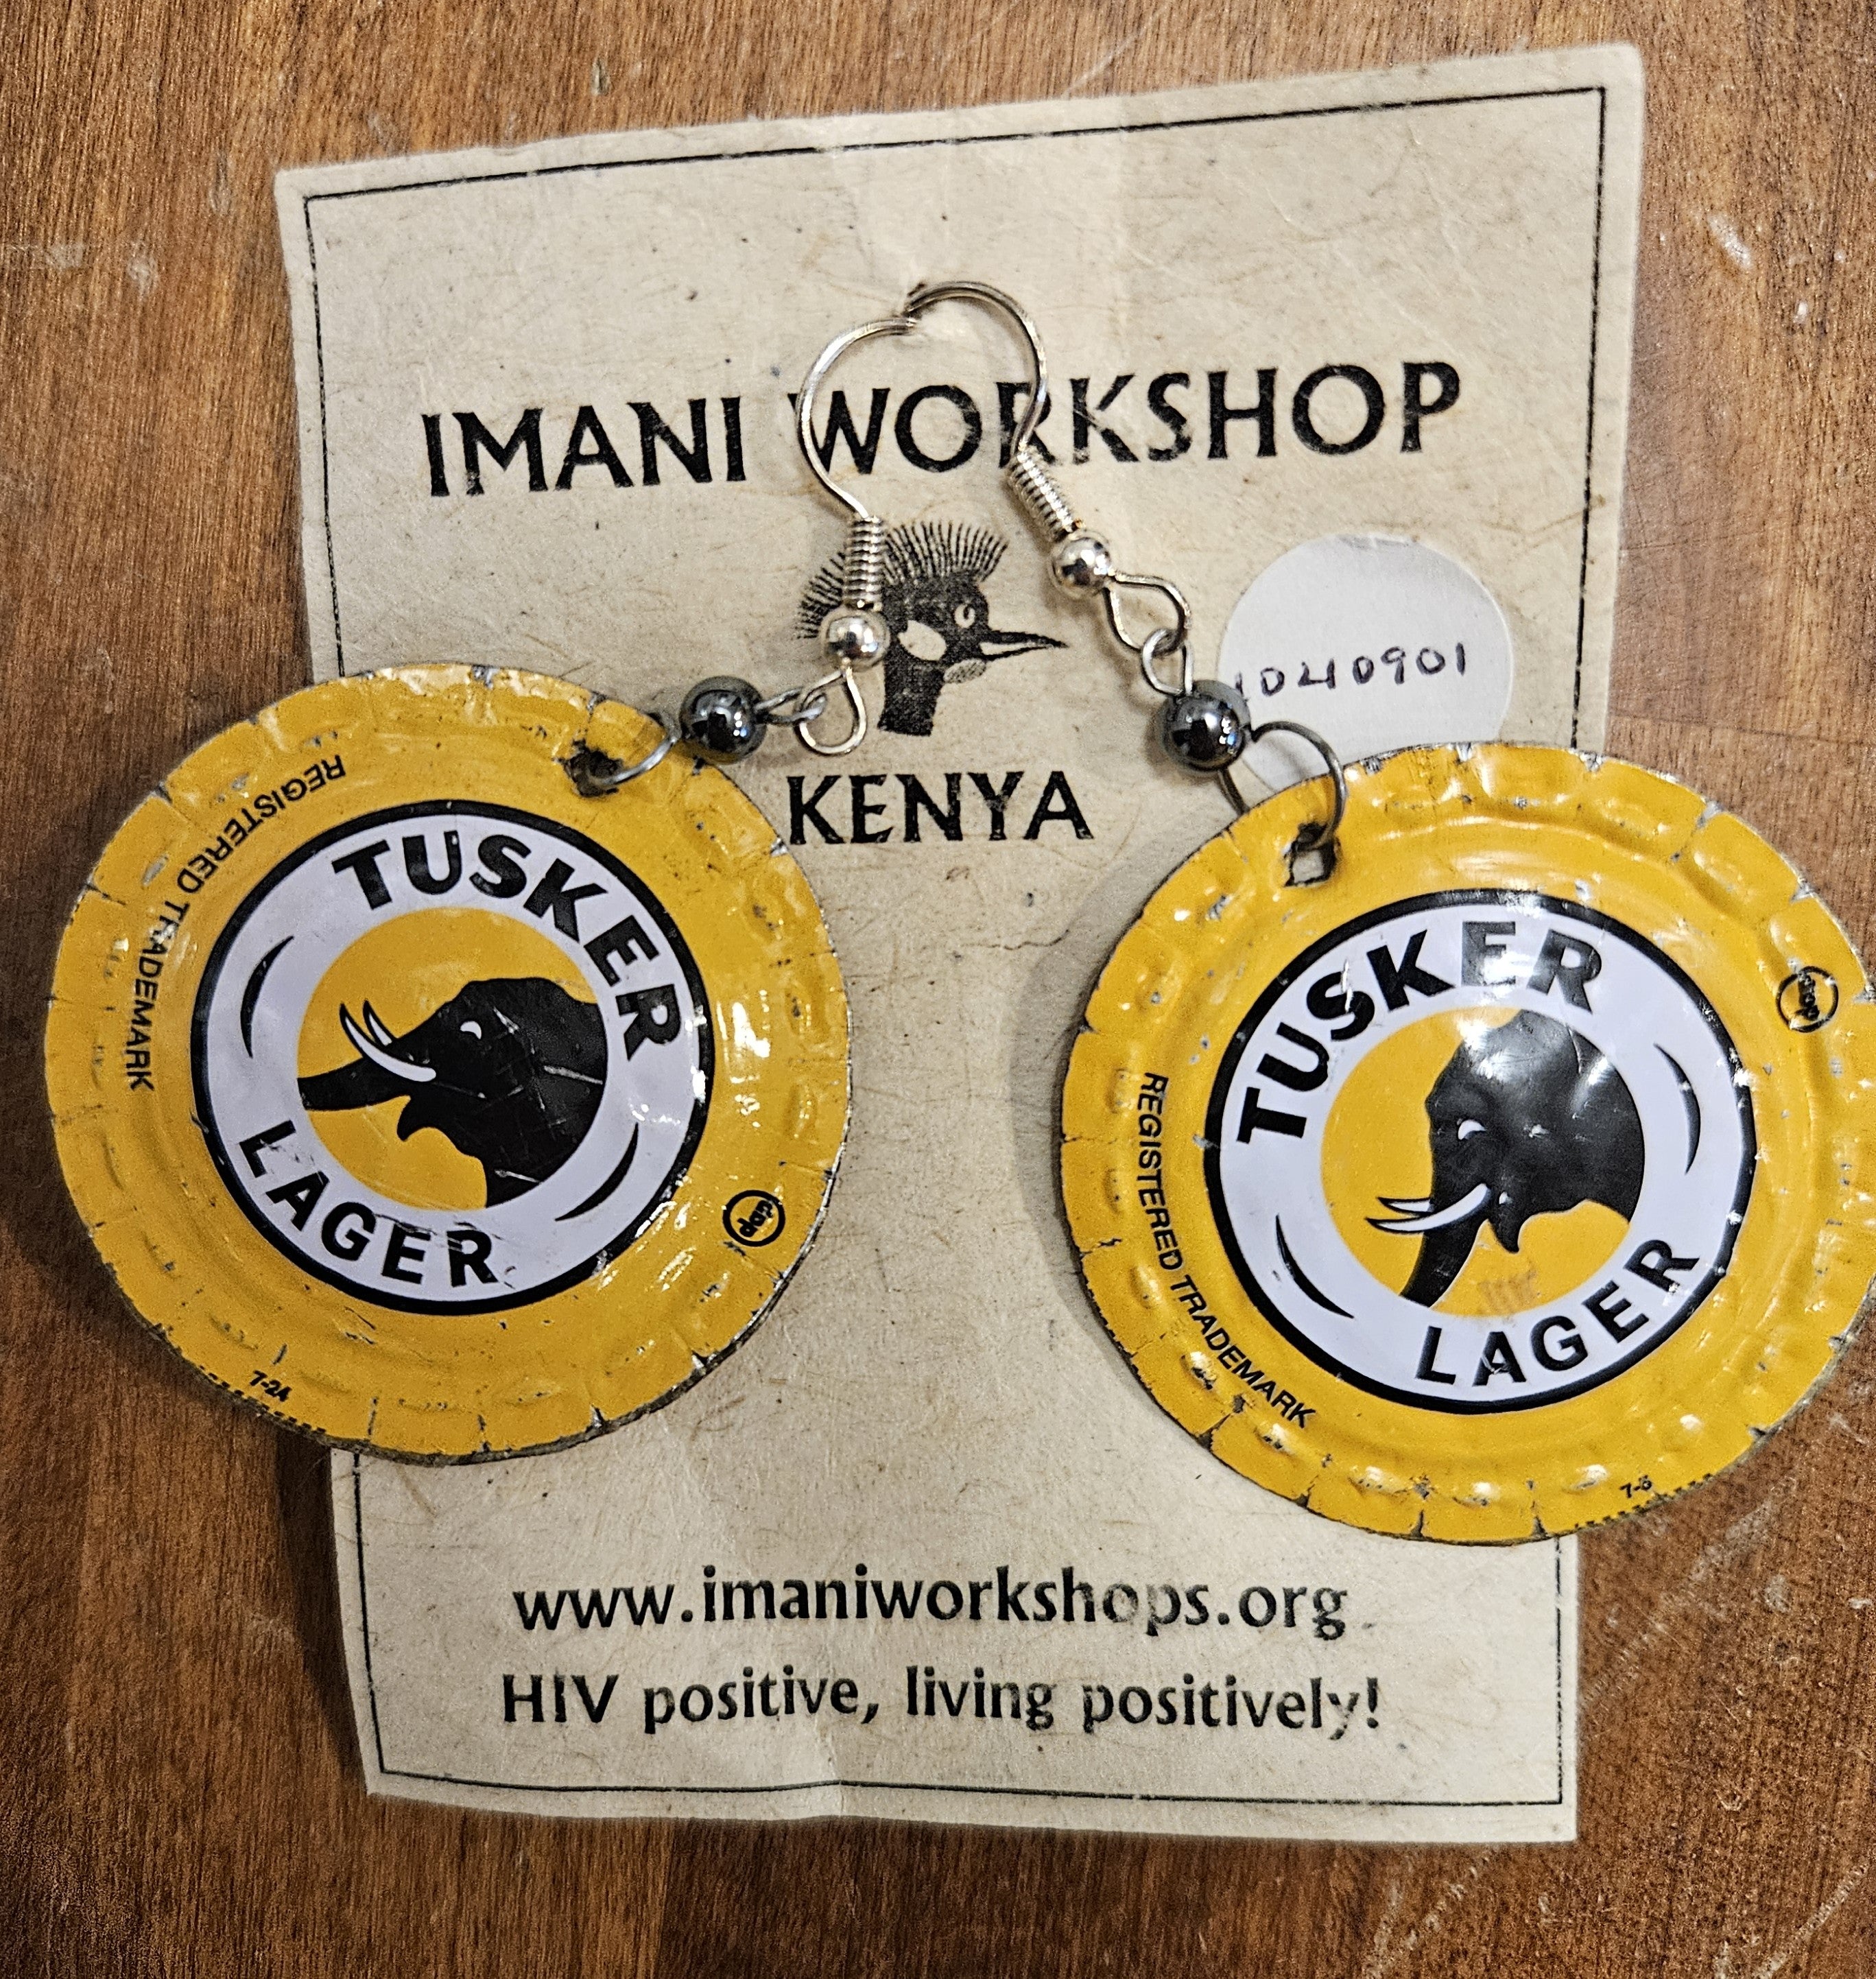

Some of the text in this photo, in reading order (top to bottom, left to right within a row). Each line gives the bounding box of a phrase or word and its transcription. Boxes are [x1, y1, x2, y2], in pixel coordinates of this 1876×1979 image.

[420, 362, 1461, 497] IMANI WORKSHOP
[176, 755, 346, 894] REGISTERED
[787, 770, 1095, 846] KENYA
[331, 829, 682, 1062] TUSKER
[1237, 919, 1602, 1145] TUSKER
[239, 1119, 499, 1290] LAGER
[1136, 1072, 1316, 1430] REGISTERED TRADEMARK
[1416, 1239, 1701, 1387] LAGER
[250, 1369, 292, 1402] 7-24
[512, 1563, 1349, 1641] www.imaniworkshops.org
[503, 1665, 1380, 1741] HIV positive, living positively!
